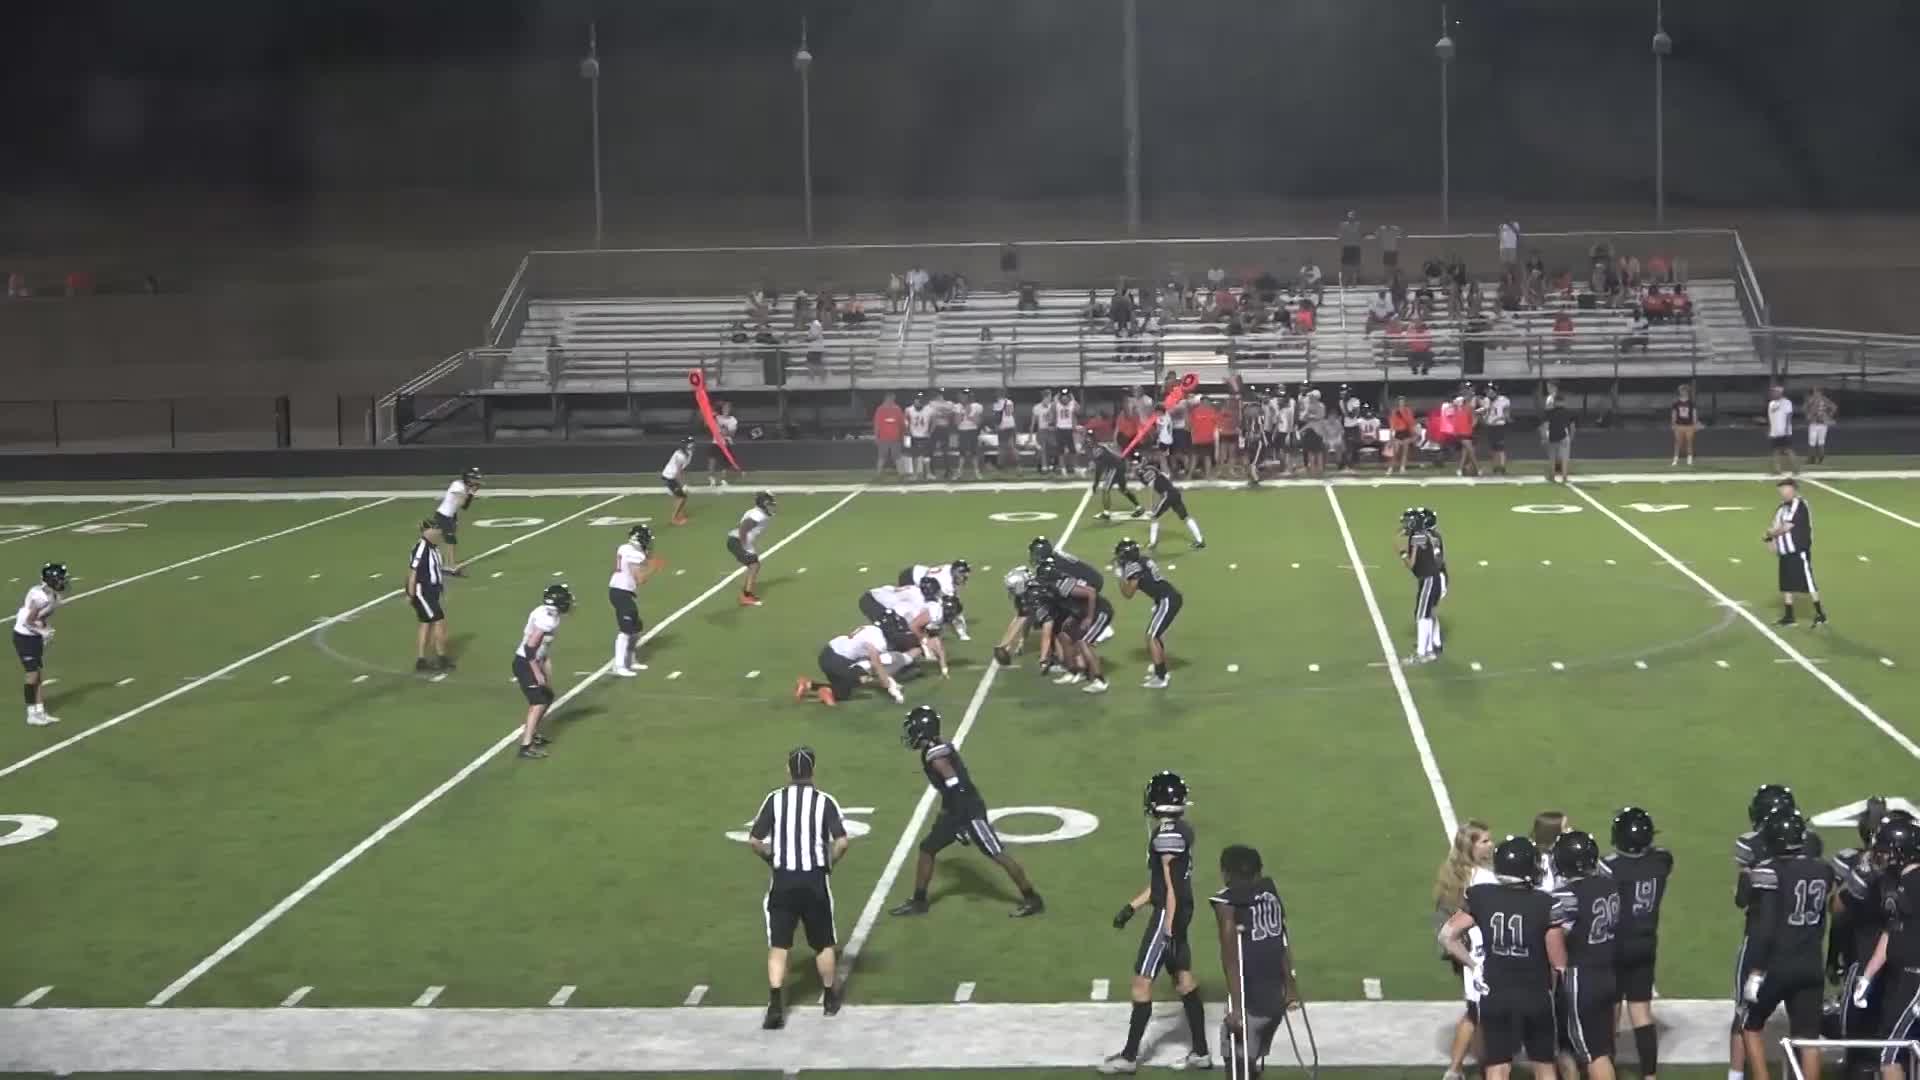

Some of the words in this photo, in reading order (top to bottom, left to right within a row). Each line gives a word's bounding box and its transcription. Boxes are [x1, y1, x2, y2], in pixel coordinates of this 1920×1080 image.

[1250, 891, 1283, 942] 10
[1632, 877, 1657, 913] 9
[1788, 878, 1827, 926] 13
[1489, 911, 1529, 957] 11
